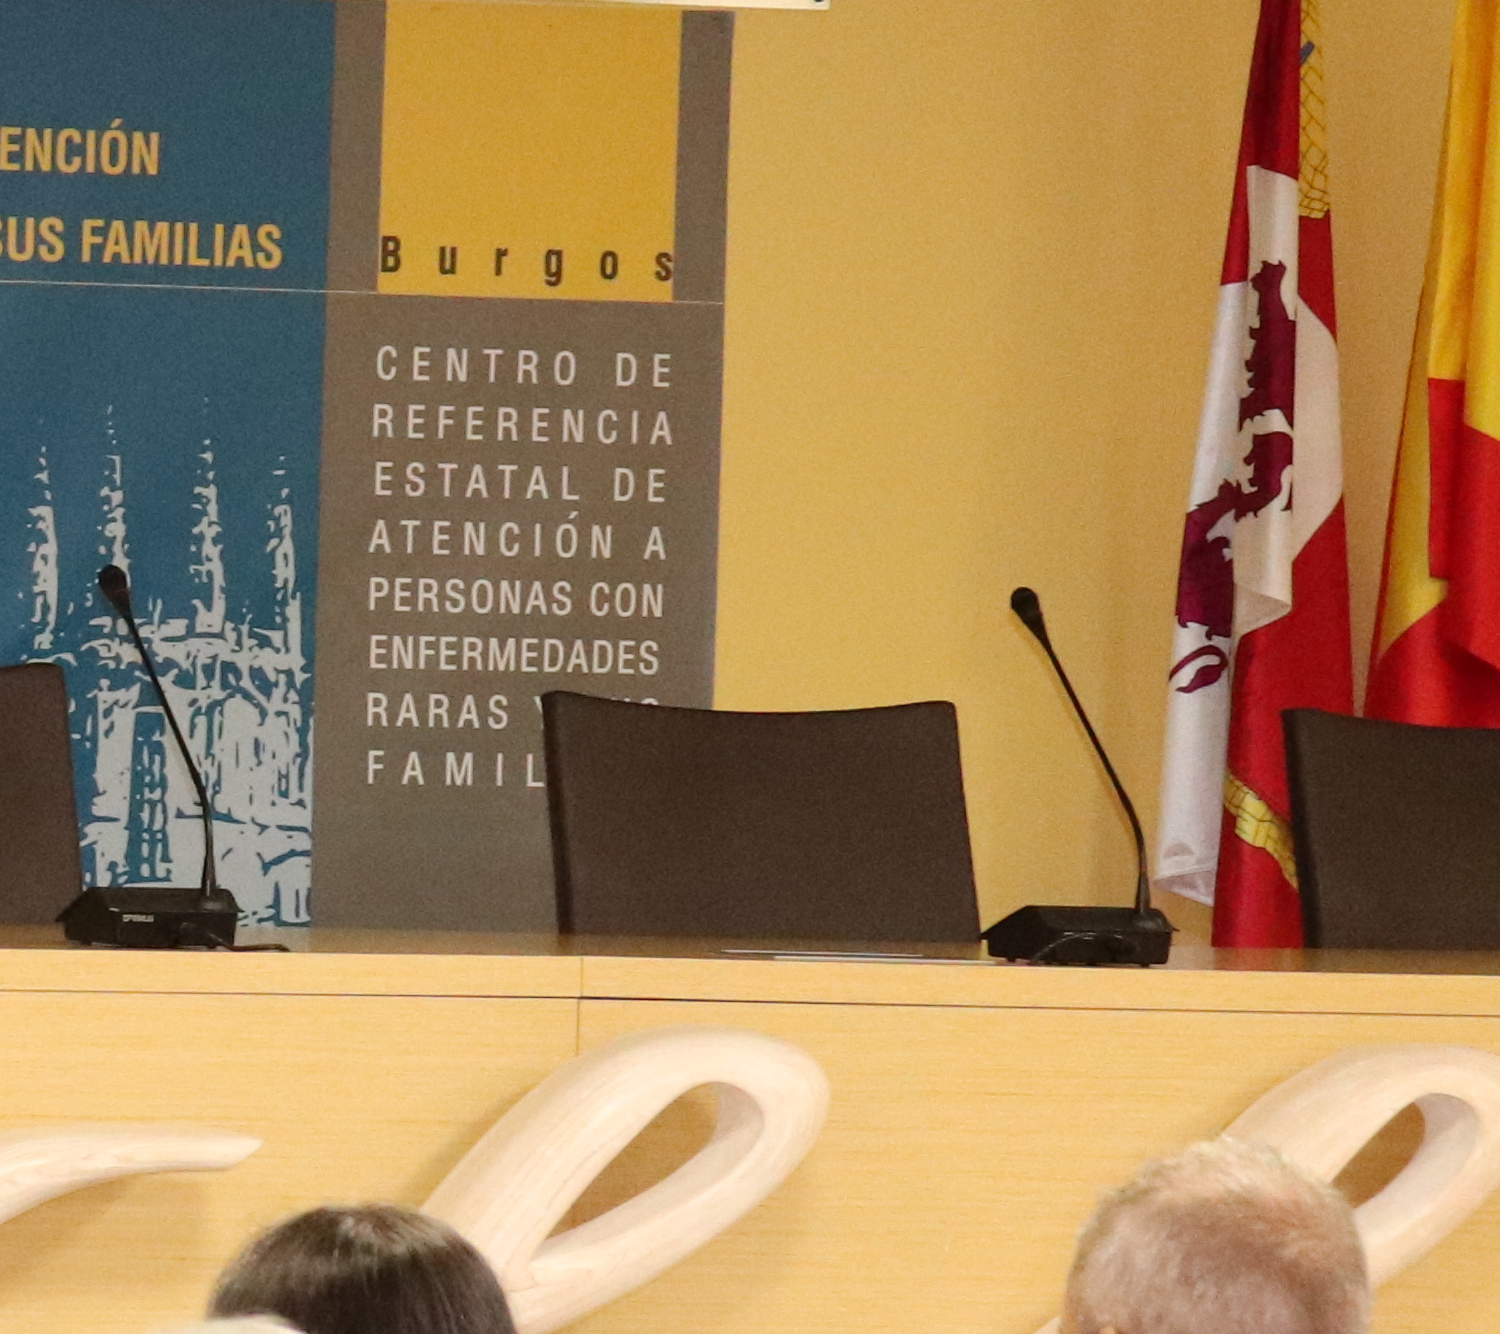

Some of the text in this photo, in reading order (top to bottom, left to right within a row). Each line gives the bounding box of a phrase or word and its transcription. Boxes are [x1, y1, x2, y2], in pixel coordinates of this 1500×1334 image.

[80, 220, 282, 269] FAMILIAS
[380, 236, 673, 286] Burgos
[377, 345, 672, 388] CENTRO DE
[372, 403, 673, 446] REFERENCIA
[375, 462, 666, 502] ESTATAL DE
[369, 512, 666, 559] ATENCIÓN A
[369, 577, 664, 617] PERSONAS CON
[369, 634, 659, 675] ENFERMEDADES
[367, 693, 508, 729] RARAS
[367, 750, 546, 787] FAMIL
